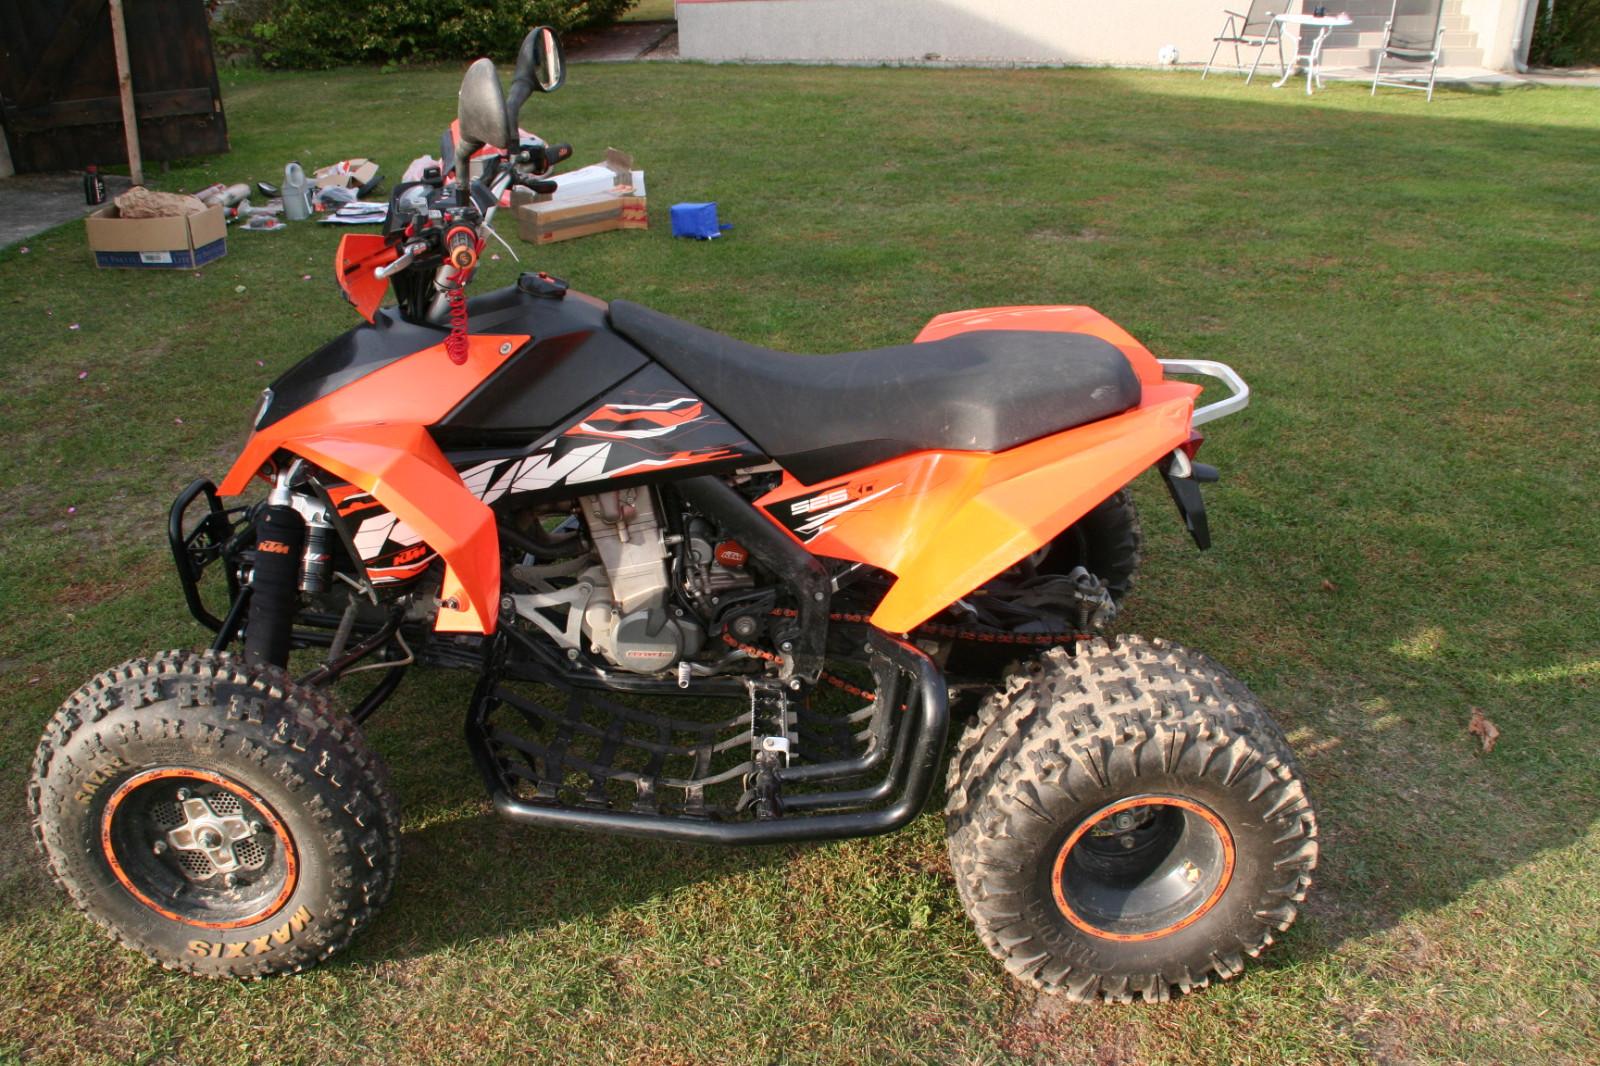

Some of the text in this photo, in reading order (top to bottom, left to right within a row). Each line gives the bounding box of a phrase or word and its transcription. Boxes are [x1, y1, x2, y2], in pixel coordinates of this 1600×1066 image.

[791, 489, 848, 515] 525
[257, 540, 290, 554] KTM
[393, 545, 427, 566] KTM
[187, 904, 314, 958] MAXXIS
